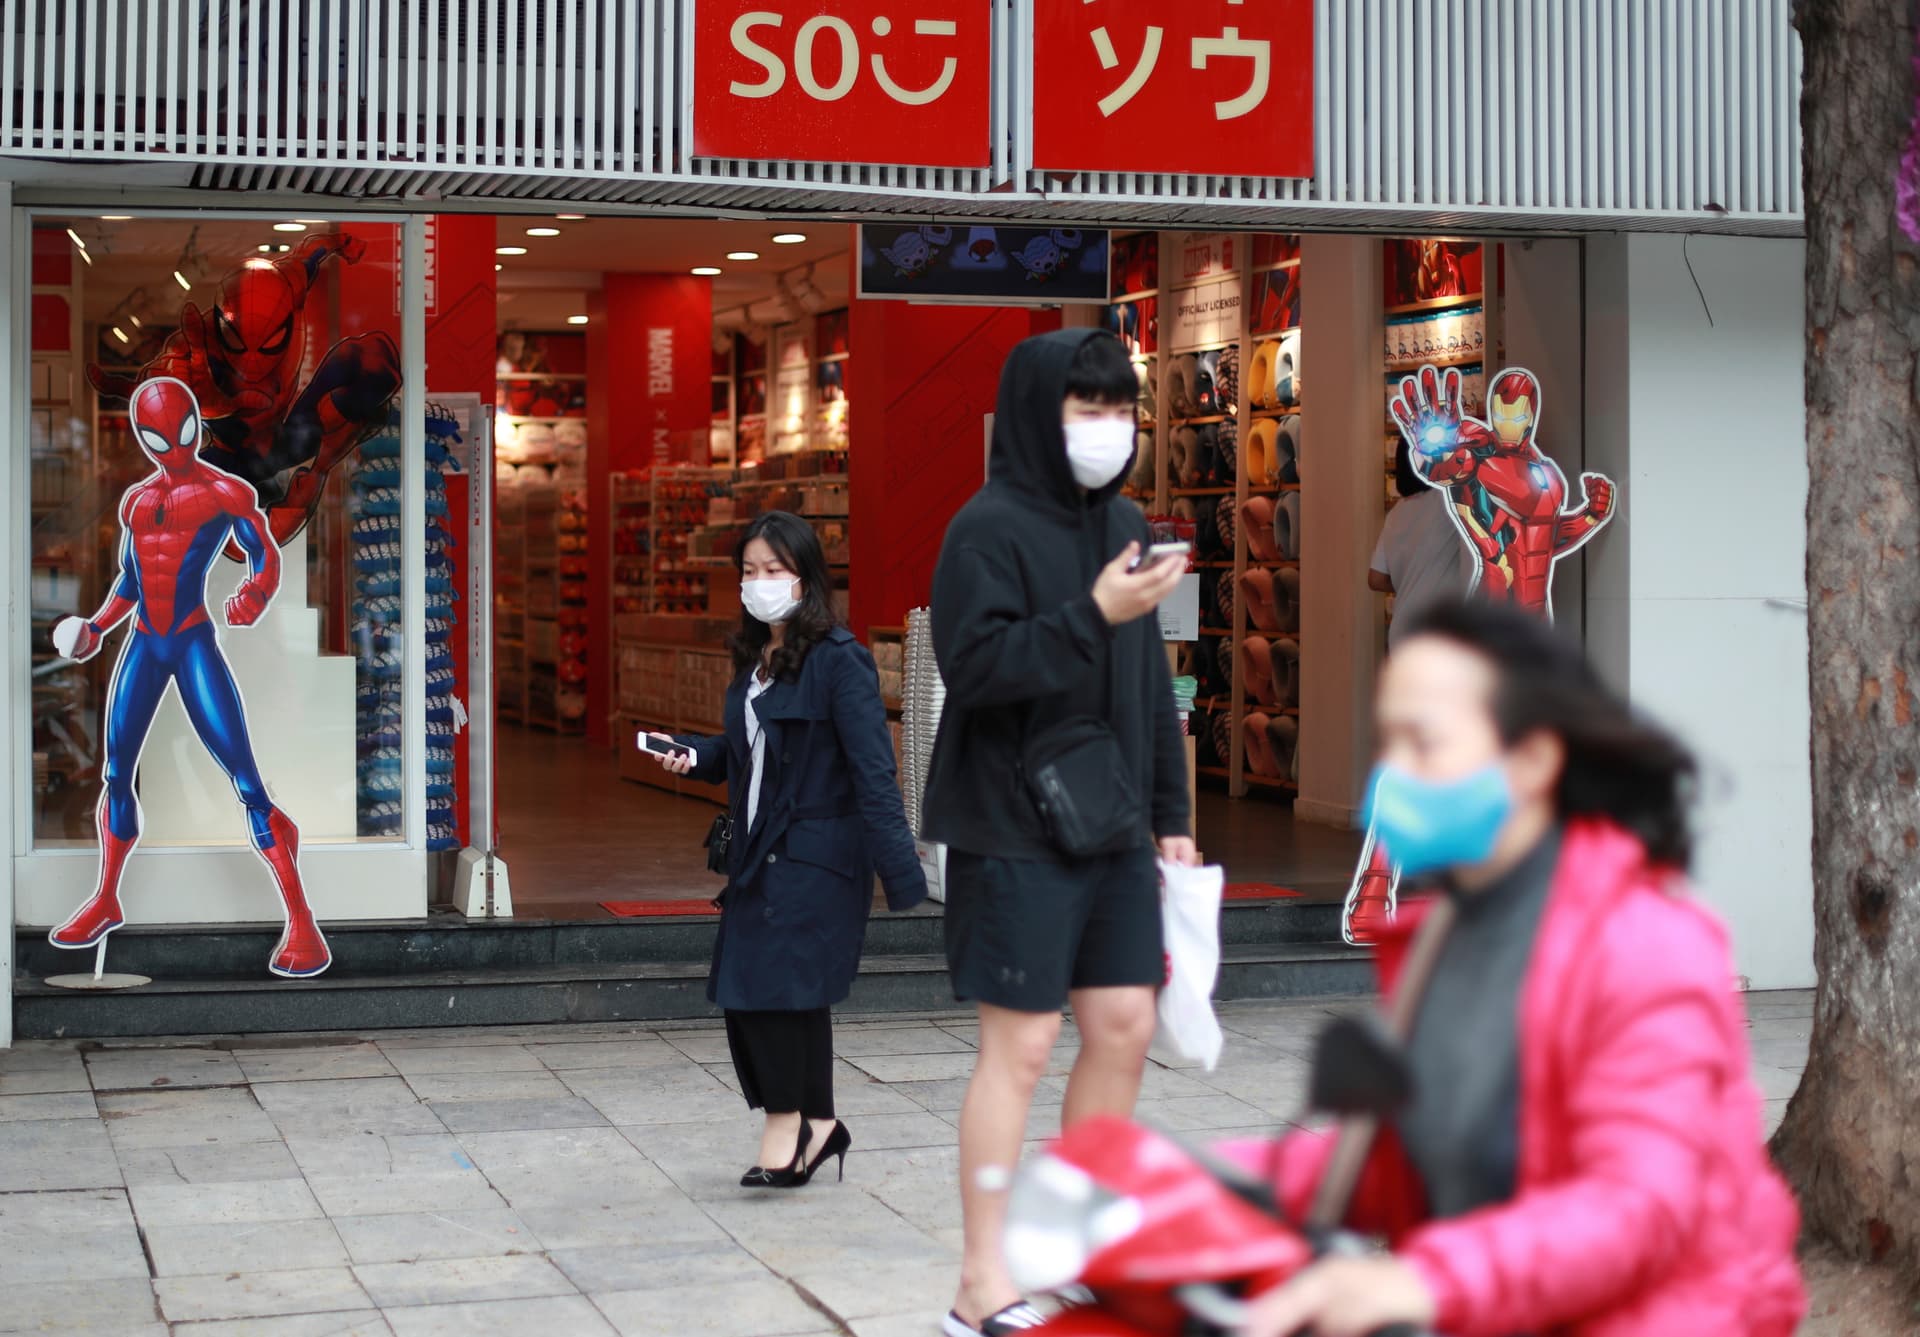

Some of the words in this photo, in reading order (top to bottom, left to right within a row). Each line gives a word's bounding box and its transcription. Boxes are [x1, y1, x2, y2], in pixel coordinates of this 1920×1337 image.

[1178, 301, 1209, 317] OFFICIALLY
[1210, 296, 1240, 311] LICENSED
[648, 328, 672, 398] MARVEL
